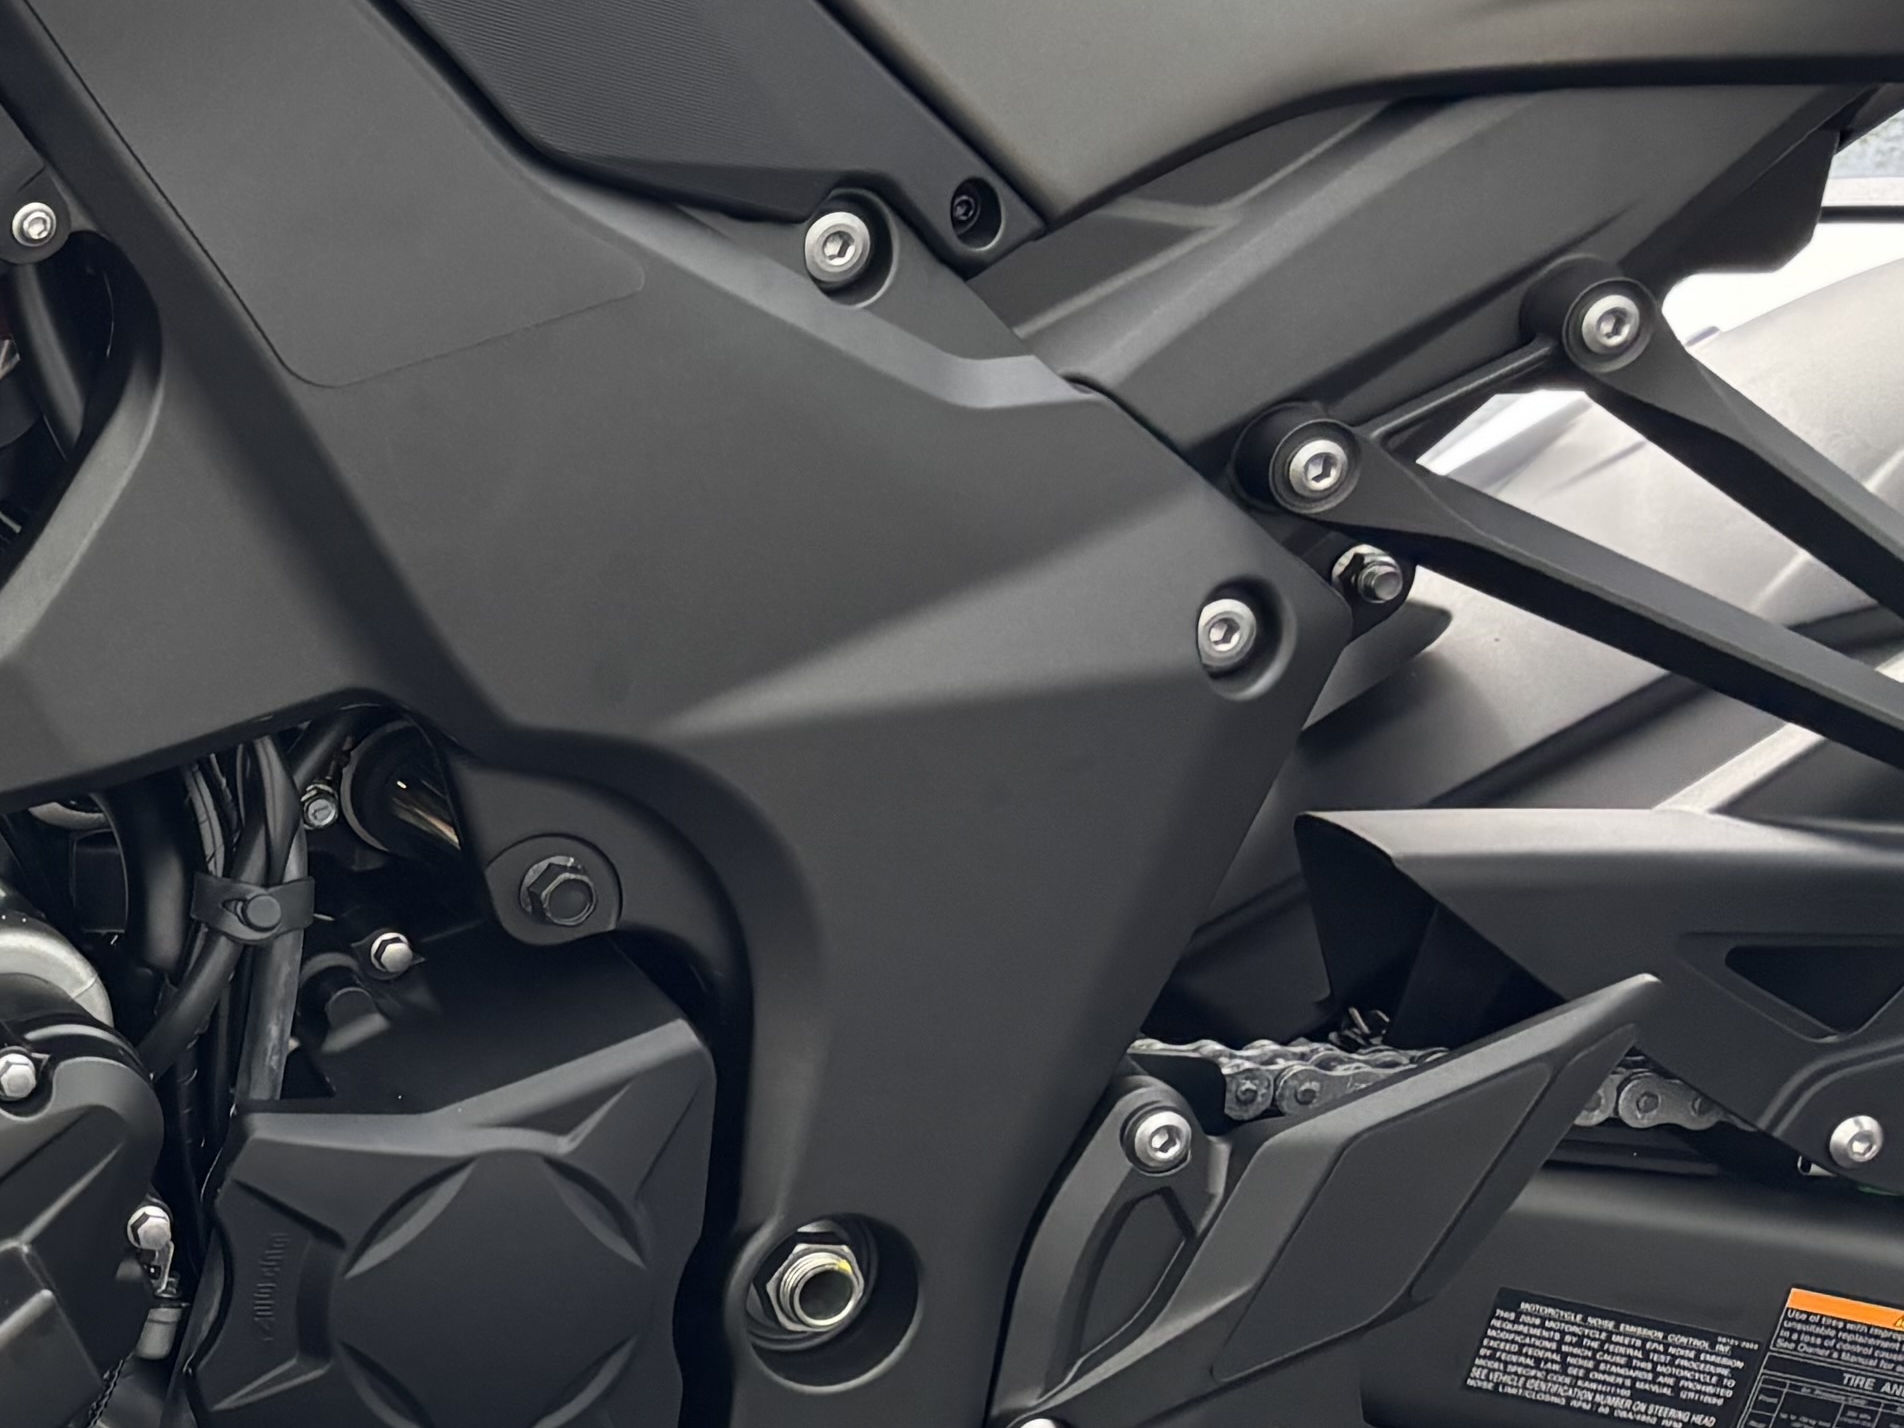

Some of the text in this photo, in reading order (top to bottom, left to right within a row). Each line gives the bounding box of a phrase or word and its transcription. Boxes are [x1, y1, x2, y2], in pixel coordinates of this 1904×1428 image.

[1519, 1301, 1583, 1322] MOTORCYCLE
[1667, 1333, 1710, 1349] CONTROL
[1544, 1319, 1607, 1339] MOTORCYCLE
[1482, 1338, 1518, 1352] EXCEED
[1835, 1340, 1872, 1355] control
[1648, 1352, 1670, 1364] TEST
[1722, 1378, 1735, 1388] TO
[1841, 1372, 1875, 1390] TIRE
[1469, 1367, 1488, 1379] SEE
[1488, 1371, 1524, 1387] VEHICLE
[1525, 1378, 1594, 1402] IDENTIFICATION
[1593, 1393, 1632, 1410] NUMBER
[1632, 1401, 1647, 1413] ON
[1646, 1404, 1690, 1422] STEERING
[1690, 1413, 1716, 1428] HEAD
